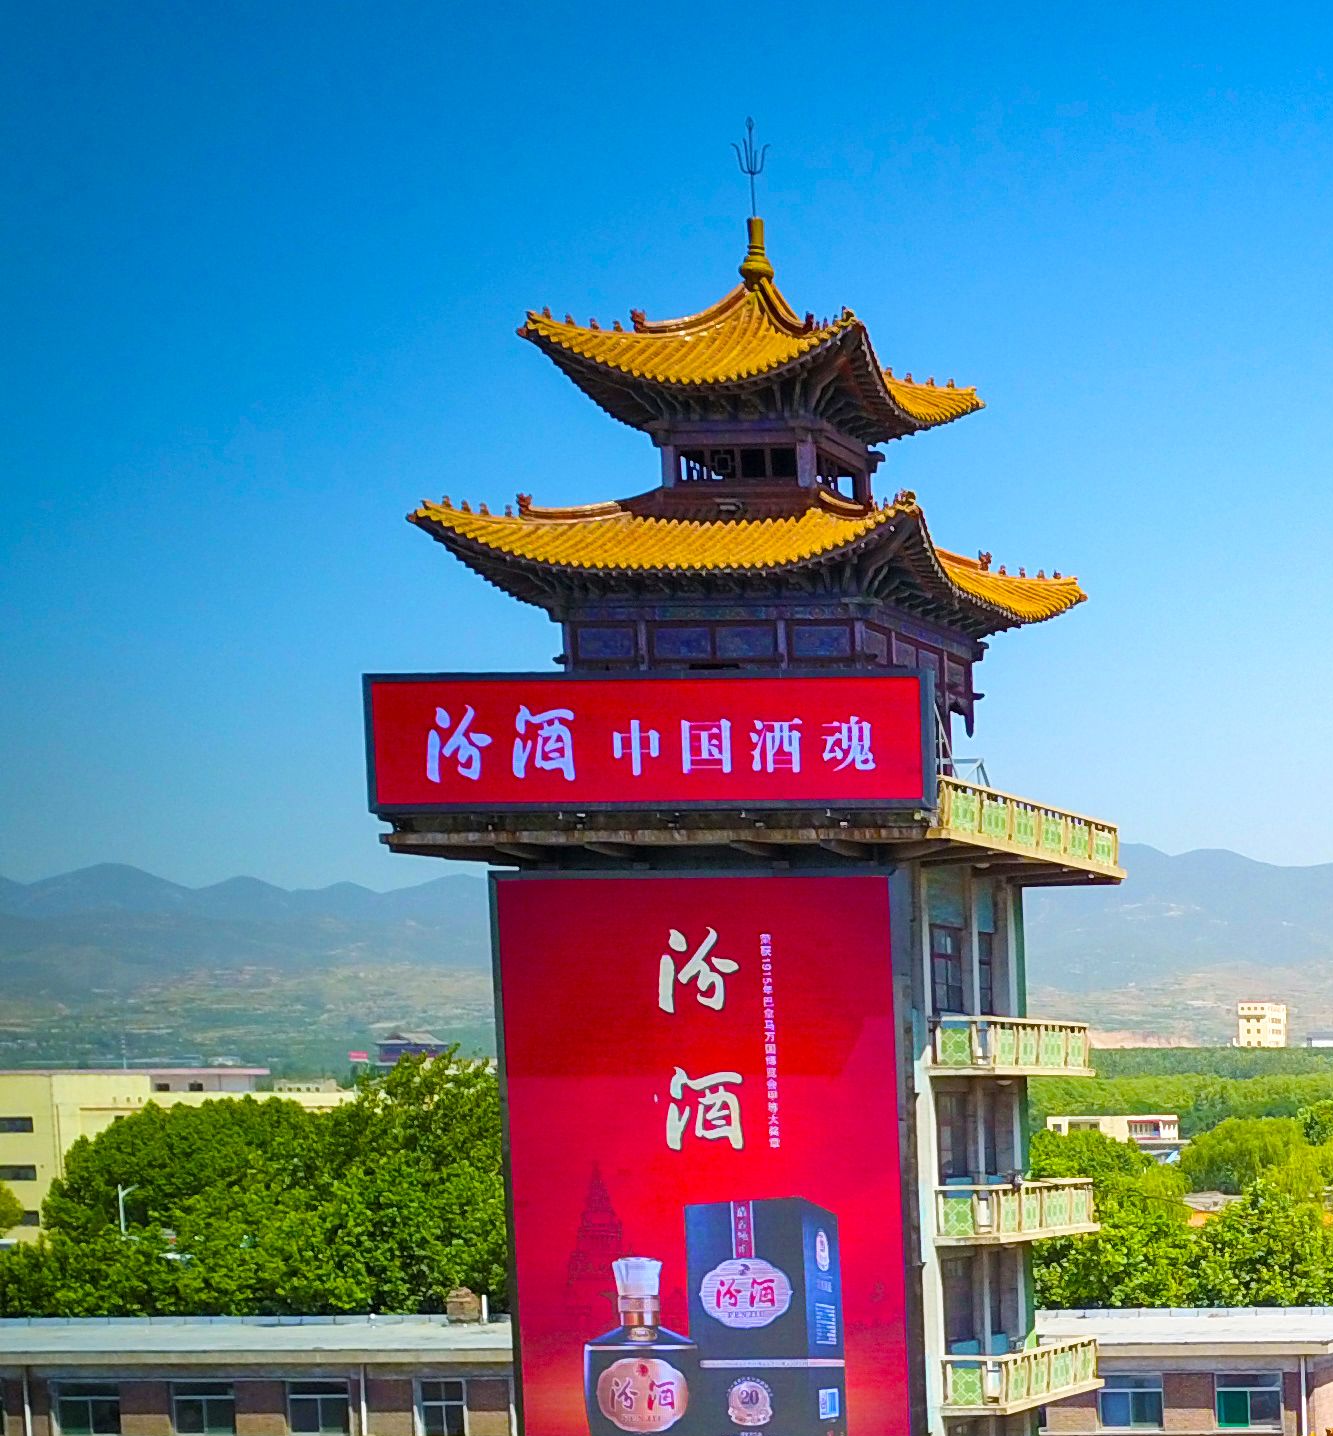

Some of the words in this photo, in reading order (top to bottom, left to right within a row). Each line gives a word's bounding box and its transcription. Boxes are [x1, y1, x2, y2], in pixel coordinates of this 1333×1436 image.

[426, 704, 577, 783] 汾酒
[611, 714, 876, 777] 中国酒魂
[656, 926, 746, 1152] 汾酒
[715, 1278, 776, 1309] 汾酒
[610, 1377, 675, 1411] 汾酒
[740, 1389, 760, 1404] 20
